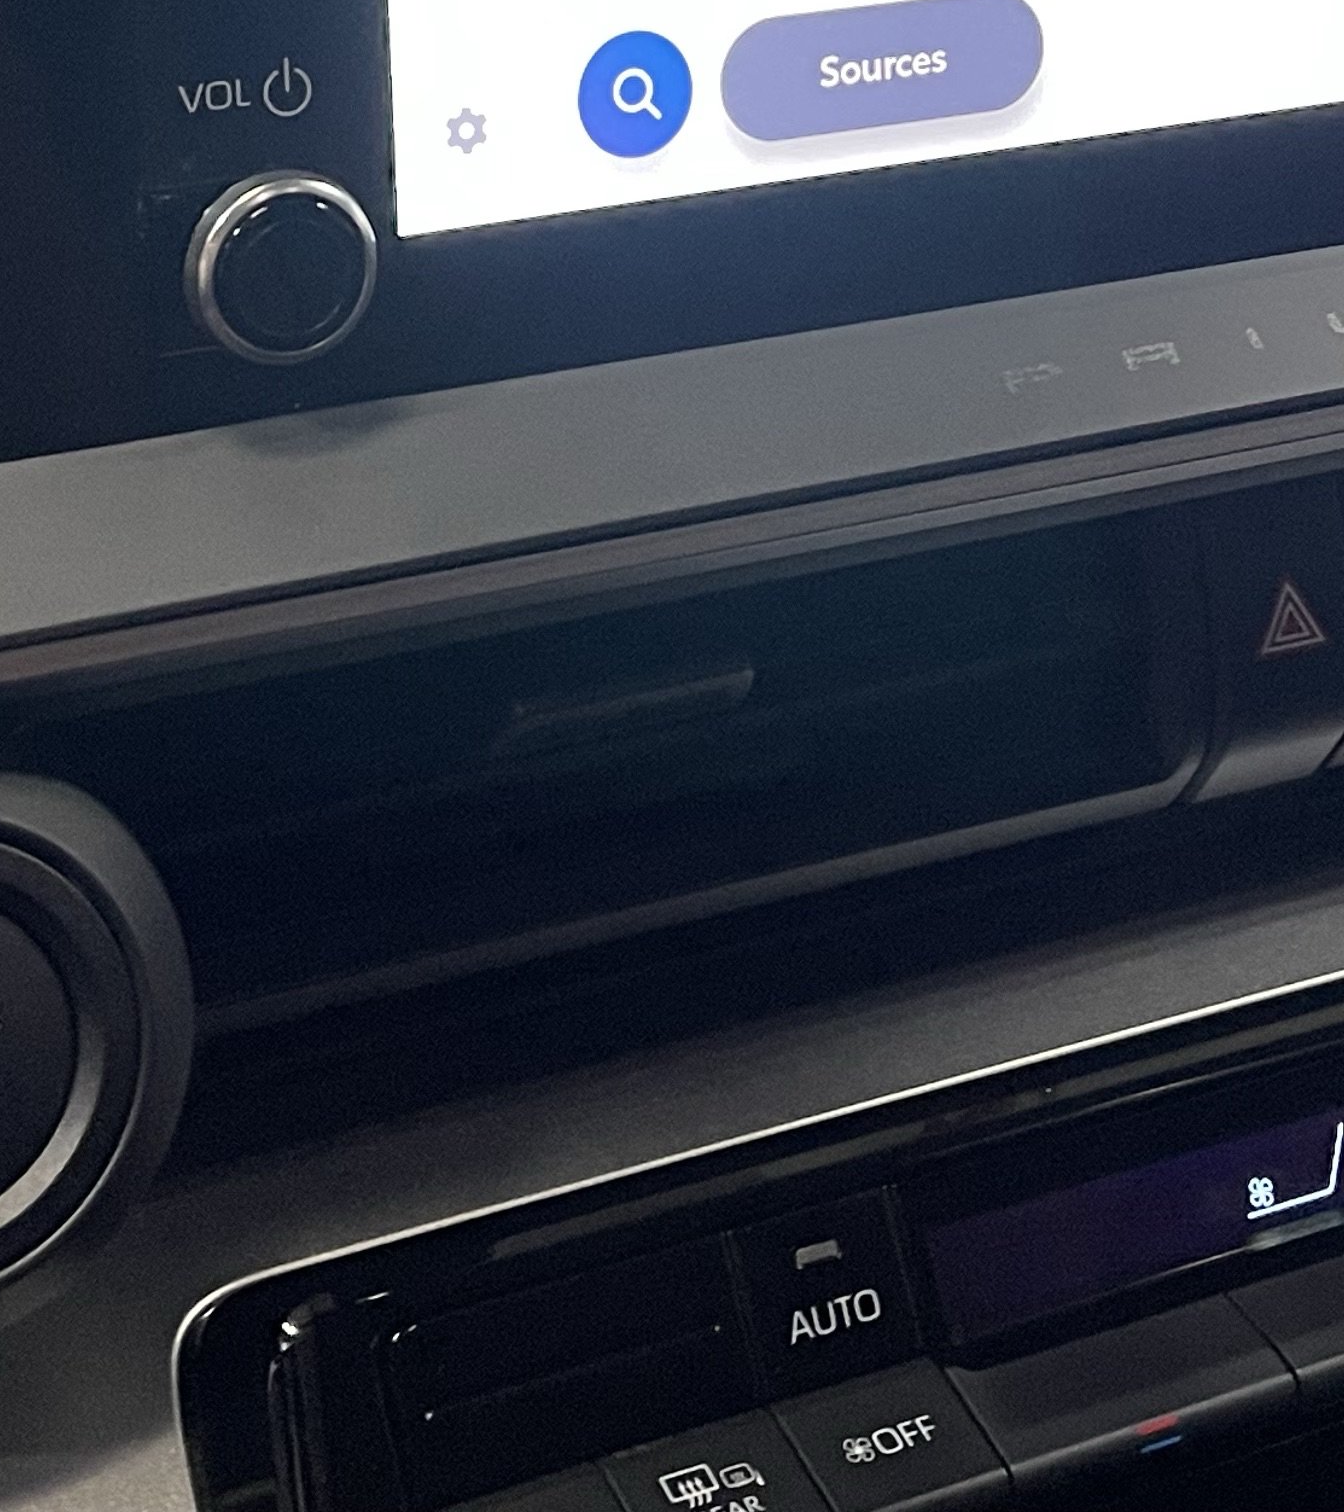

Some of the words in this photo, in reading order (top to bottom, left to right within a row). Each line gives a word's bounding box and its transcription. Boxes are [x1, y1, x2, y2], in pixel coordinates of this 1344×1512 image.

[818, 48, 948, 89] Sources
[177, 78, 252, 115] VOL
[790, 1288, 882, 1346] AUTO
[871, 1414, 937, 1455] OFF
